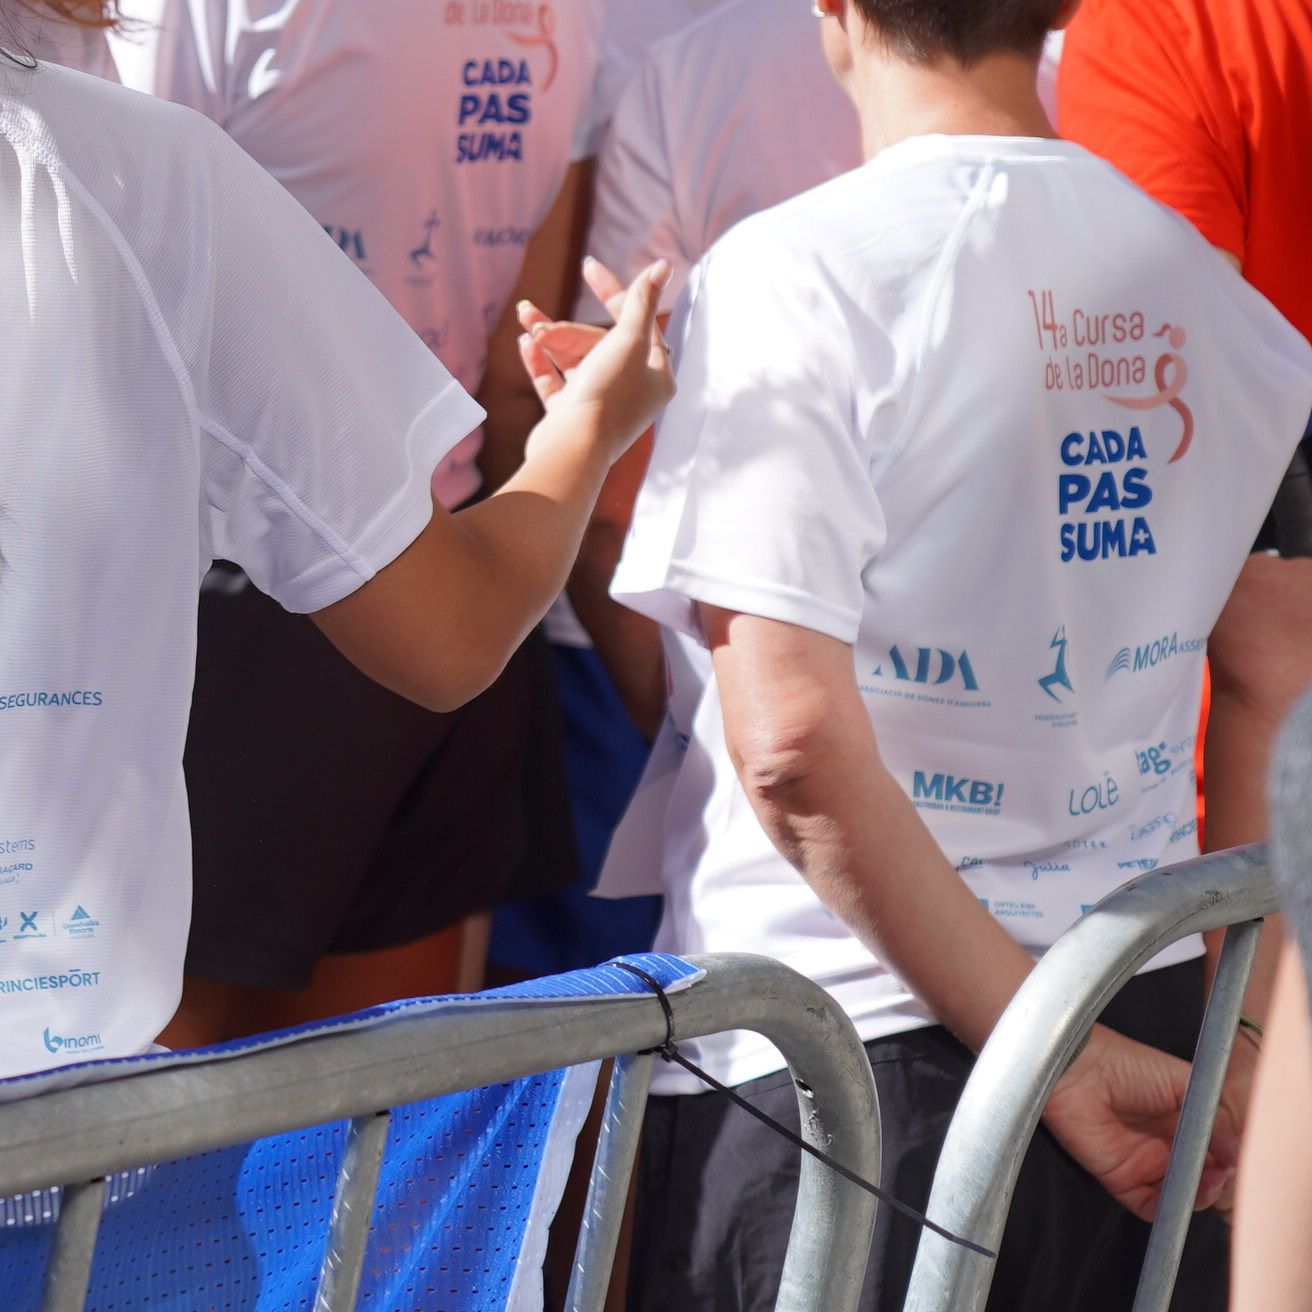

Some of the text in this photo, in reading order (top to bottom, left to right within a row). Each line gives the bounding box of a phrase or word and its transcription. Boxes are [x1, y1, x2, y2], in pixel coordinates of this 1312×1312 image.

[463, 58, 532, 86] CADA
[458, 92, 532, 126] PAS
[455, 130, 523, 164] SUMA
[1028, 290, 1144, 351] 14a Cursa
[1045, 353, 1145, 390] de la Dona
[1060, 426, 1148, 466] CADA
[1059, 467, 1153, 515] PAS
[1060, 517, 1157, 562] SUMA
[872, 644, 979, 692] ADA
[1133, 631, 1177, 673] MORA
[913, 771, 1005, 807] MKB!
